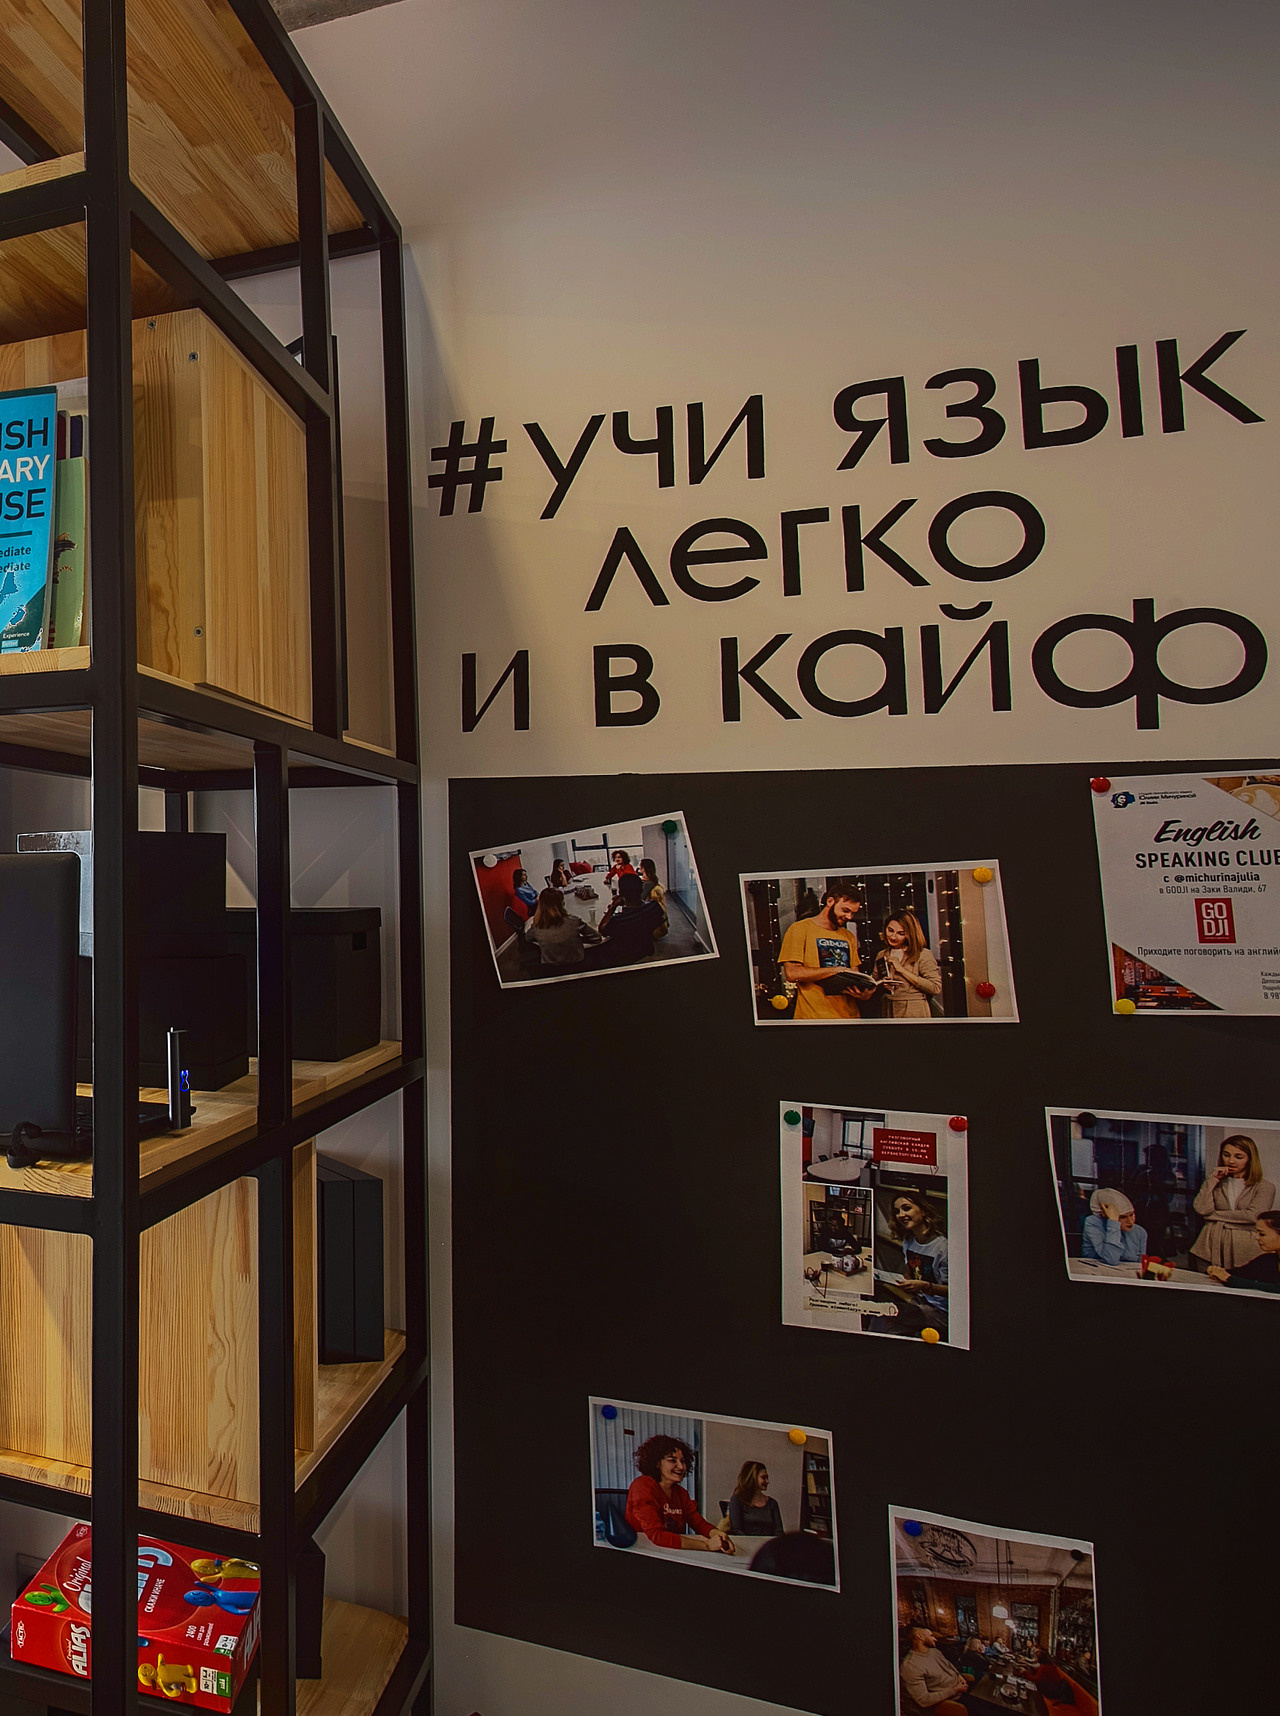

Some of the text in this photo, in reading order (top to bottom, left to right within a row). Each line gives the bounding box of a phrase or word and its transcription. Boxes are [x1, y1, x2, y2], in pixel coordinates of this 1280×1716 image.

[834, 328, 1266, 471] язык
[584, 490, 1047, 613] легко
[720, 597, 1269, 731] кайф
[1153, 818, 1262, 847] English
[1135, 851, 1231, 869] SPEAKING
[1174, 871, 1261, 884] @michurinajulia
[1166, 886, 1189, 894] GODJI
[1201, 886, 1221, 894] Заки
[1223, 885, 1256, 894] Валиди,
[1257, 884, 1267, 893] 67
[1200, 902, 1227, 919] GO
[1203, 919, 1230, 936] DJI
[1137, 946, 1280, 957] Приходите поговорить на англий
[1270, 991, 1280, 999] 98
[63, 1556, 91, 1592] Original
[185, 1624, 197, 1639] 2400
[70, 1623, 91, 1676] ALIAS
